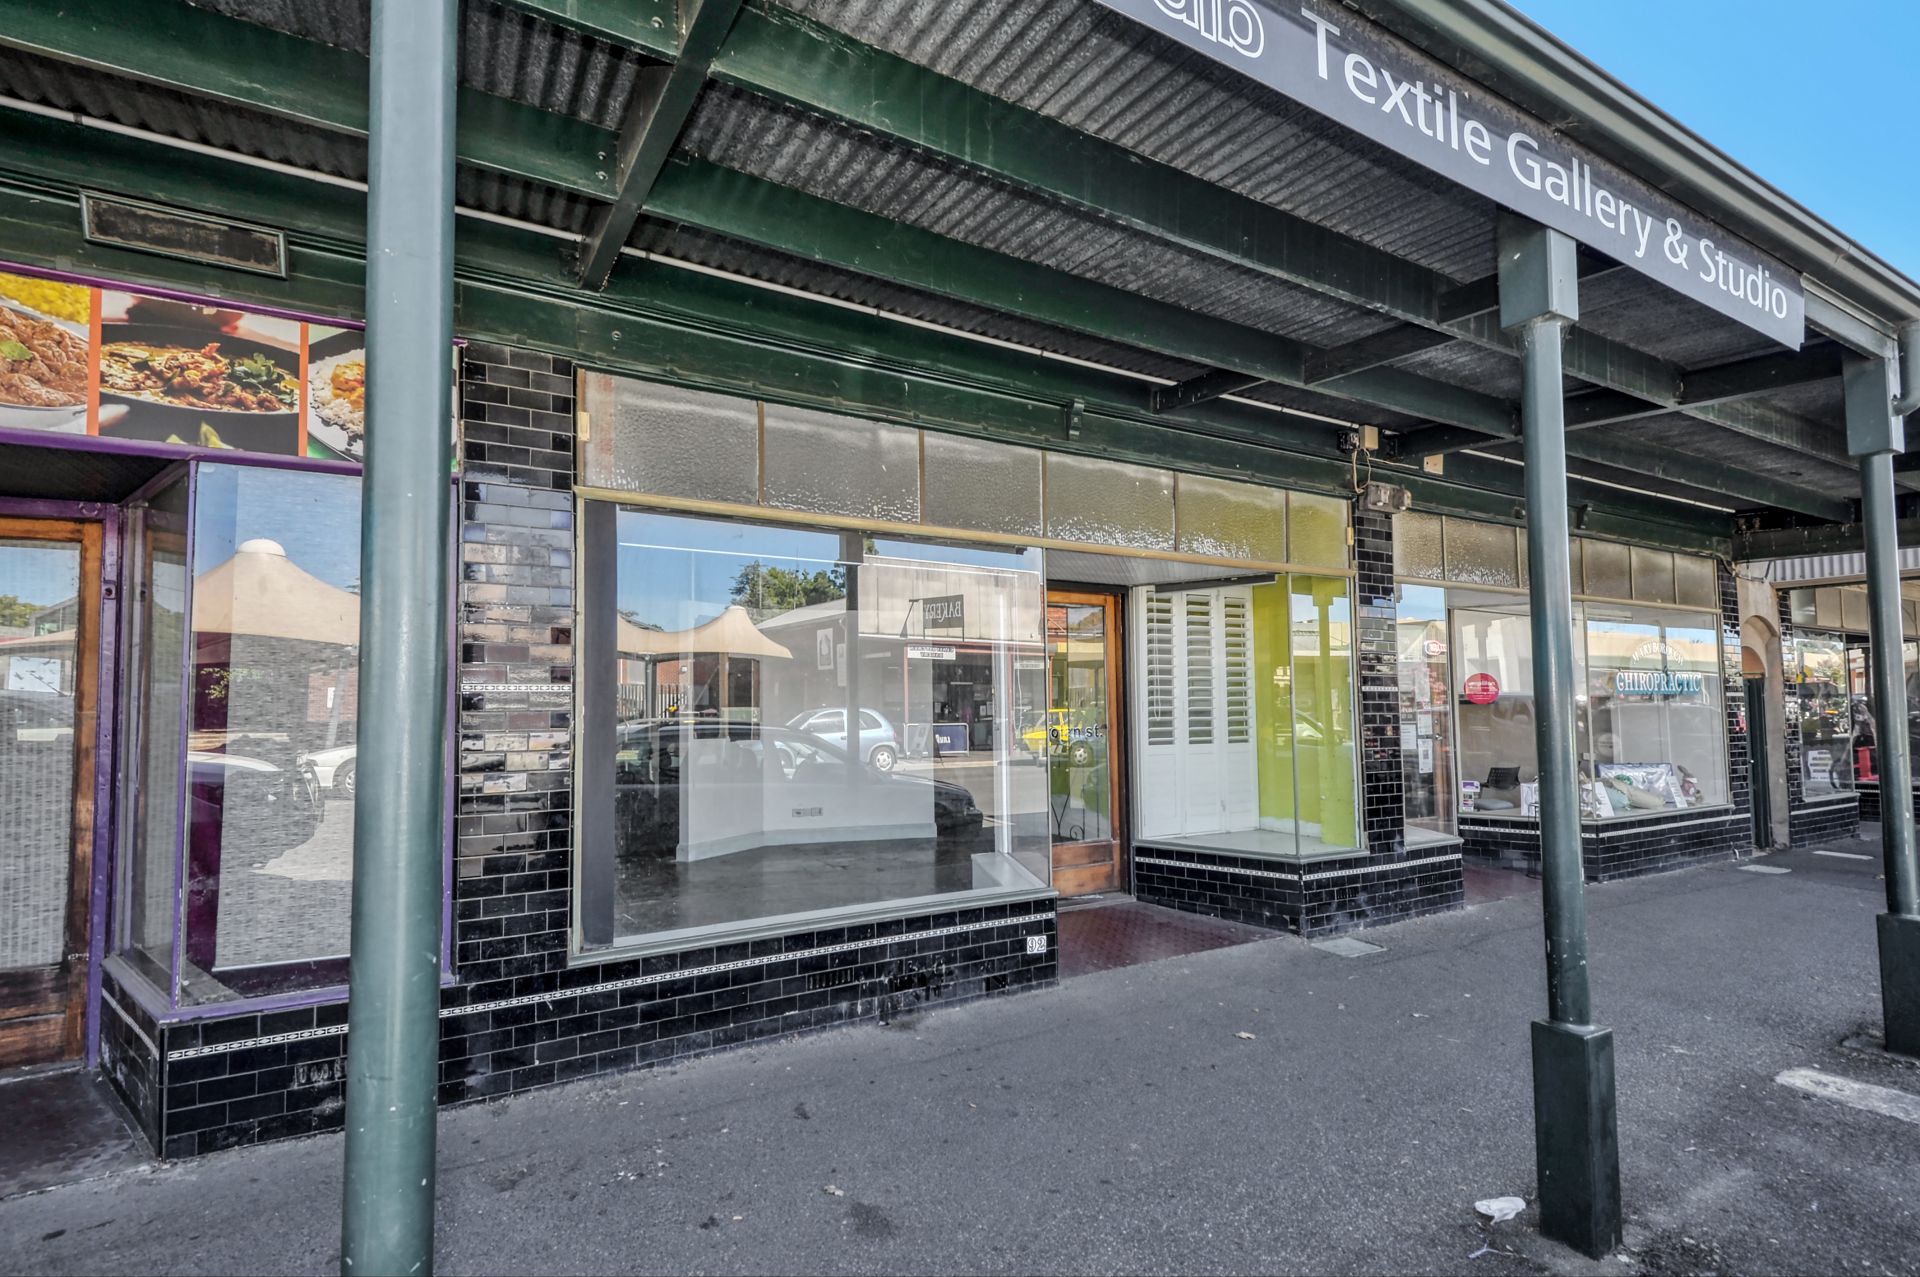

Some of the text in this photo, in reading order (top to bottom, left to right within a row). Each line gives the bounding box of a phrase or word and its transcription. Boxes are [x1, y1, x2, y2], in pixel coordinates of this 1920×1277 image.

[1301, 7, 1492, 166] Textile
[1506, 132, 1653, 258] Gallery
[1663, 217, 1689, 270] &
[1699, 238, 1788, 319] Studio
[1615, 671, 1702, 693] CHIROPRACTIC
[1028, 937, 1046, 952] 92
